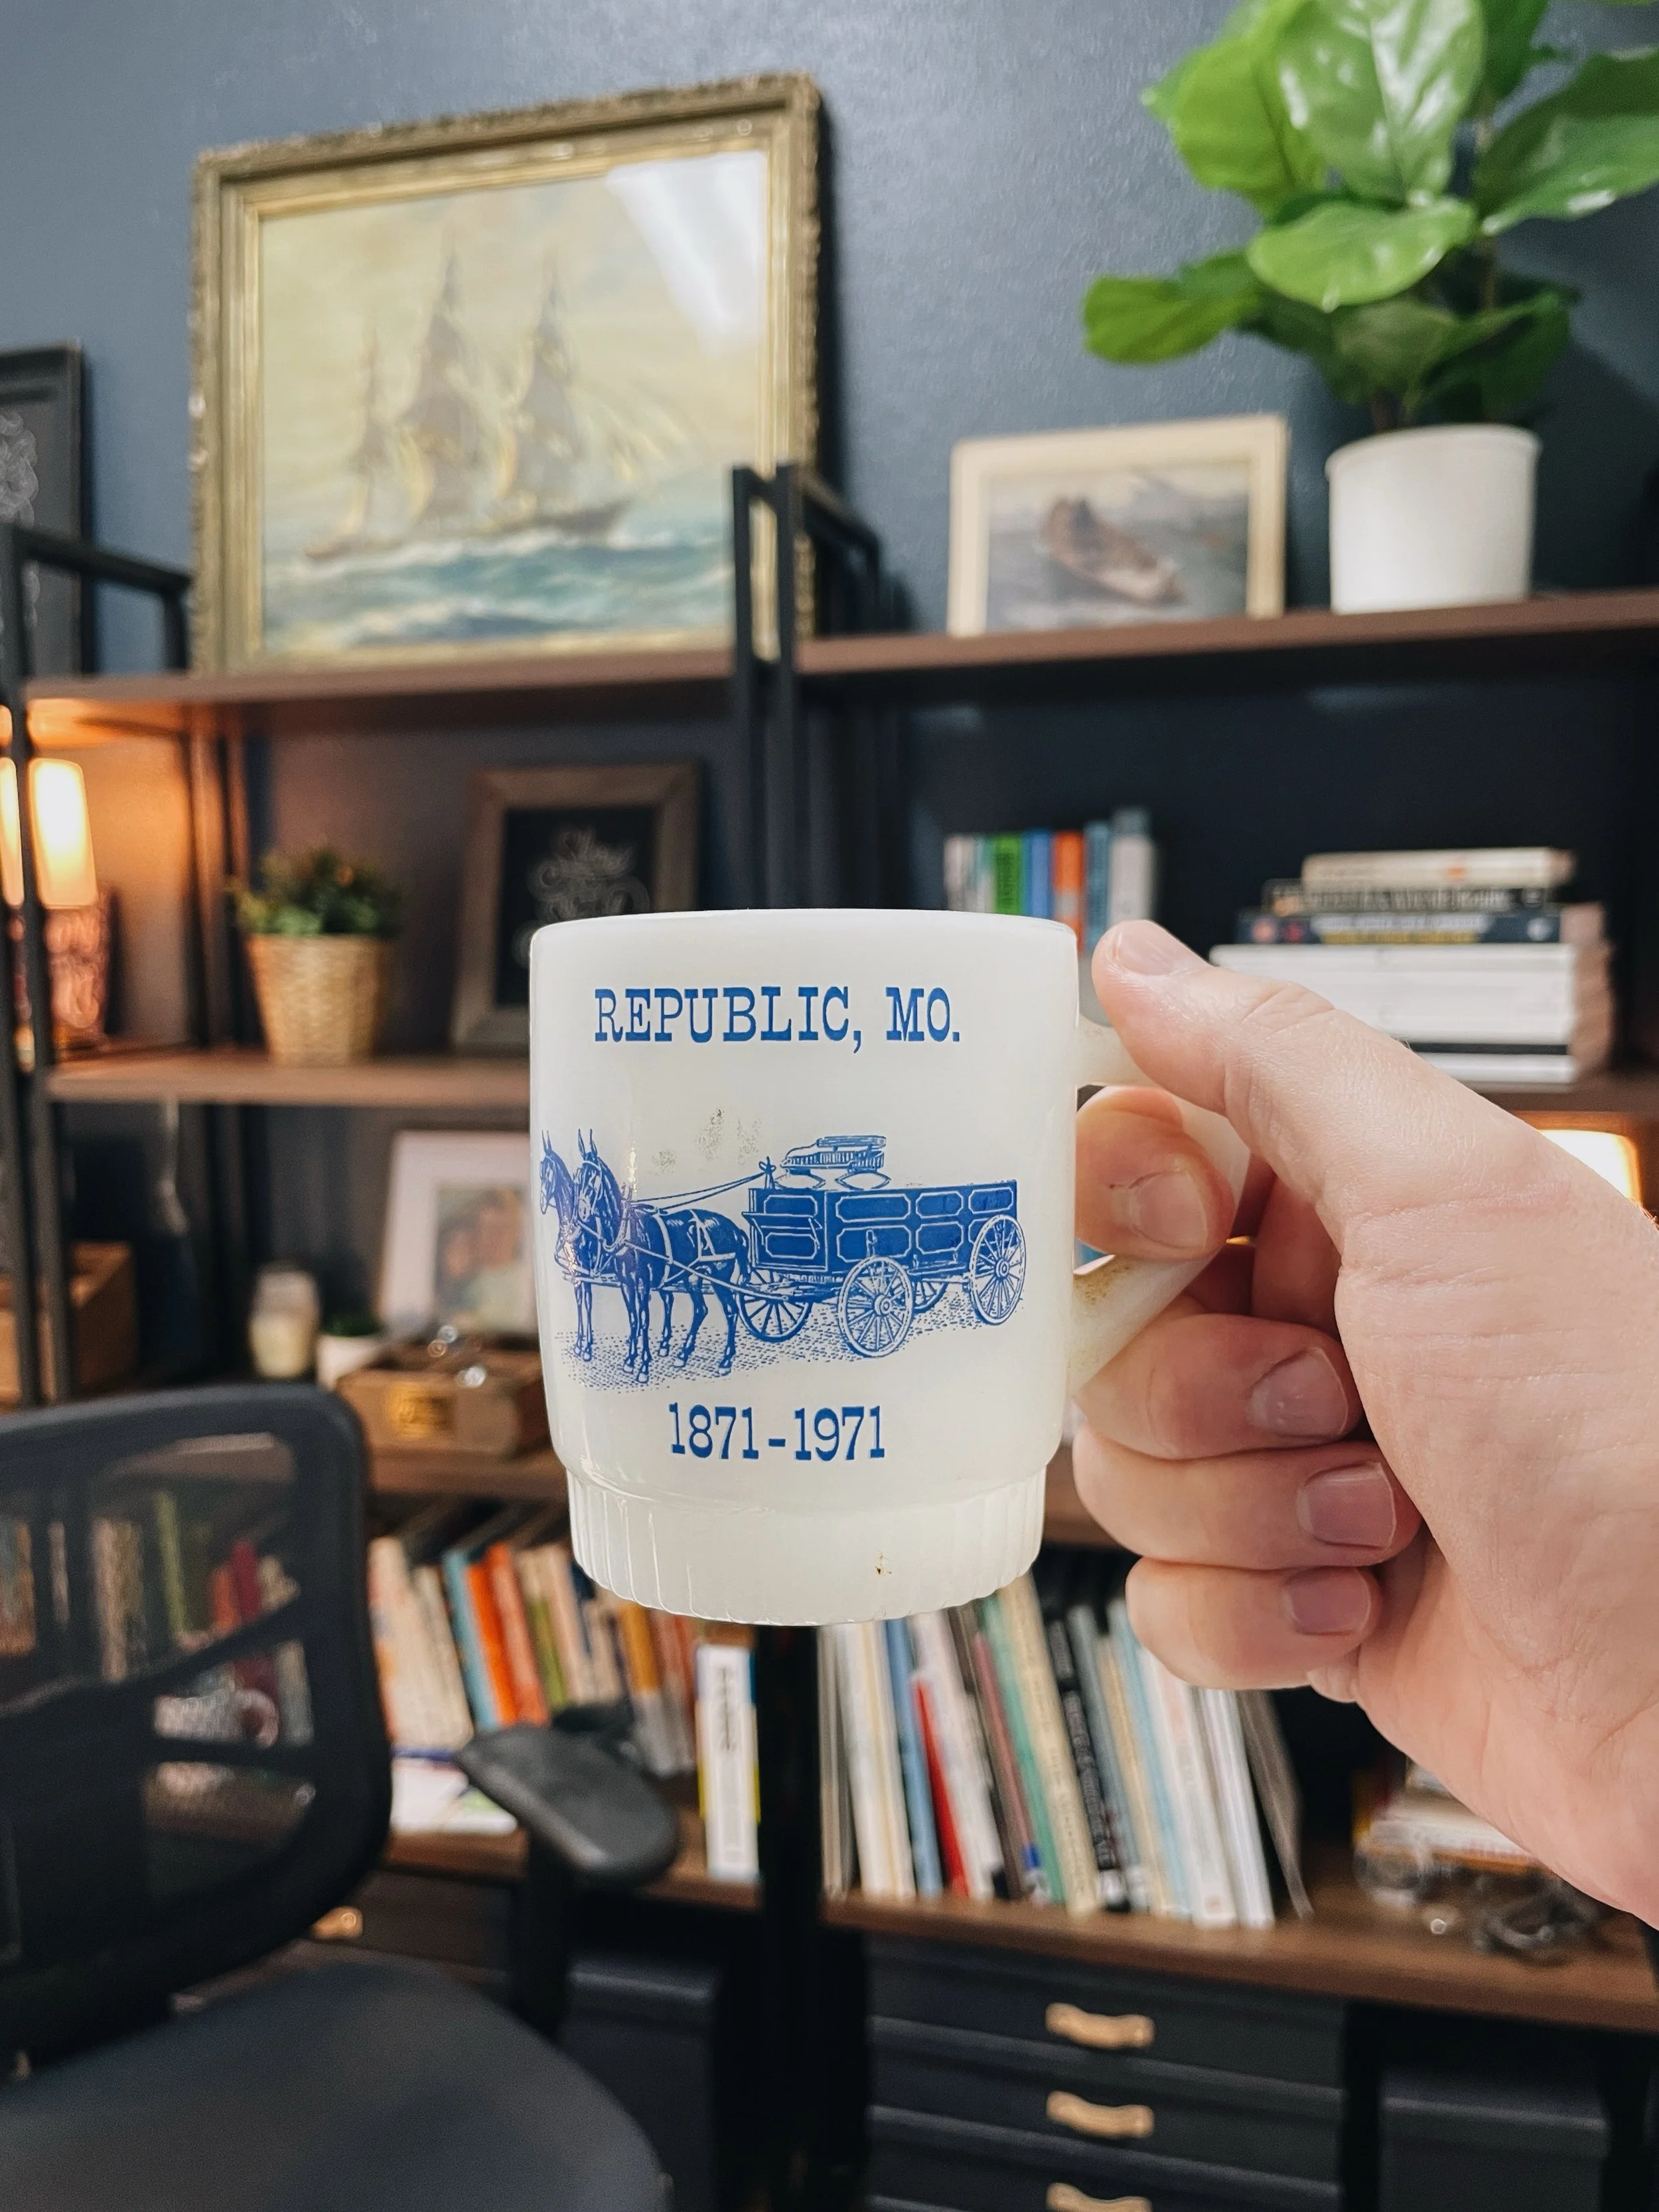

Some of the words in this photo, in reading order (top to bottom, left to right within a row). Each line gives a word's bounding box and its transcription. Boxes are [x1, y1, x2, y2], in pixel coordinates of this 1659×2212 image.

[594, 985, 861, 1053] REPUBLIC,
[885, 986, 960, 1041] MO.
[669, 1402, 885, 1461] 1871-1971
